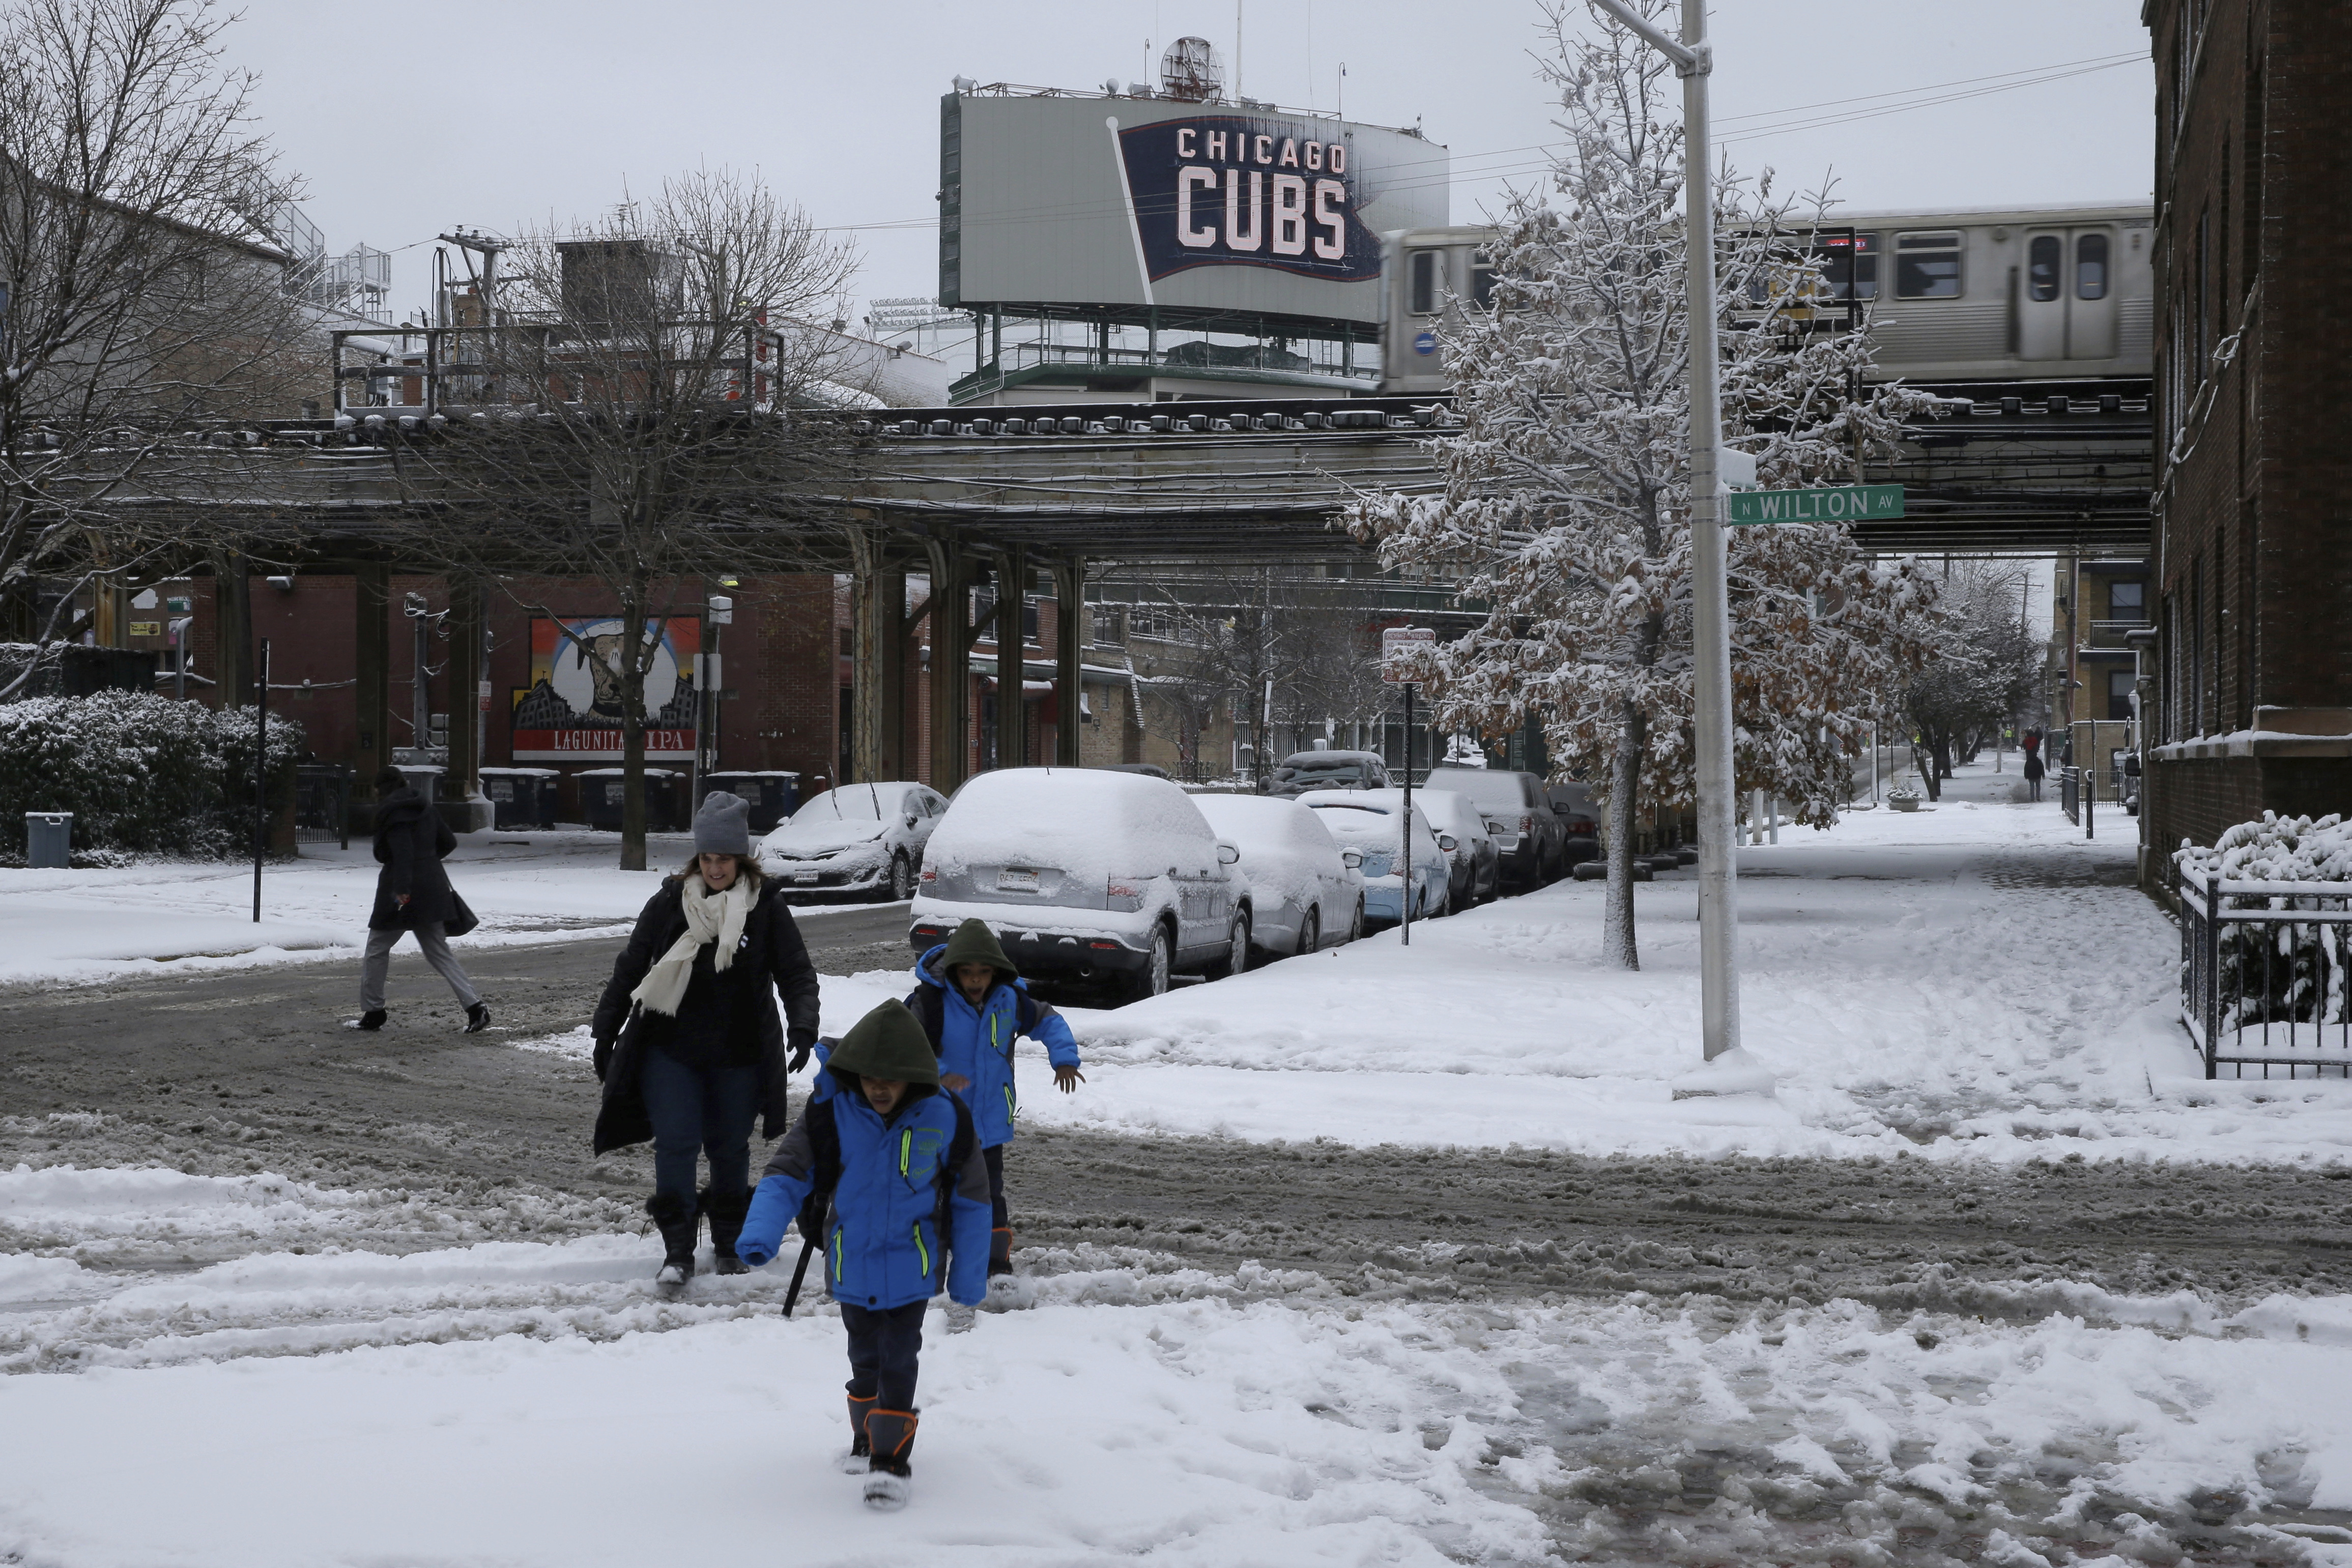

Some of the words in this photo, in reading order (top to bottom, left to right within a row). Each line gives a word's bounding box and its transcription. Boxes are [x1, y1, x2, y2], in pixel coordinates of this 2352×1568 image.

[1177, 128, 1345, 173] CHICAGO
[1178, 165, 1345, 260] CUBS
[1742, 502, 1750, 515] N
[1760, 490, 1868, 519] WILTON
[1878, 495, 1894, 509] AV
[554, 731, 625, 750] LAGUNITA
[646, 731, 684, 749] IPA
